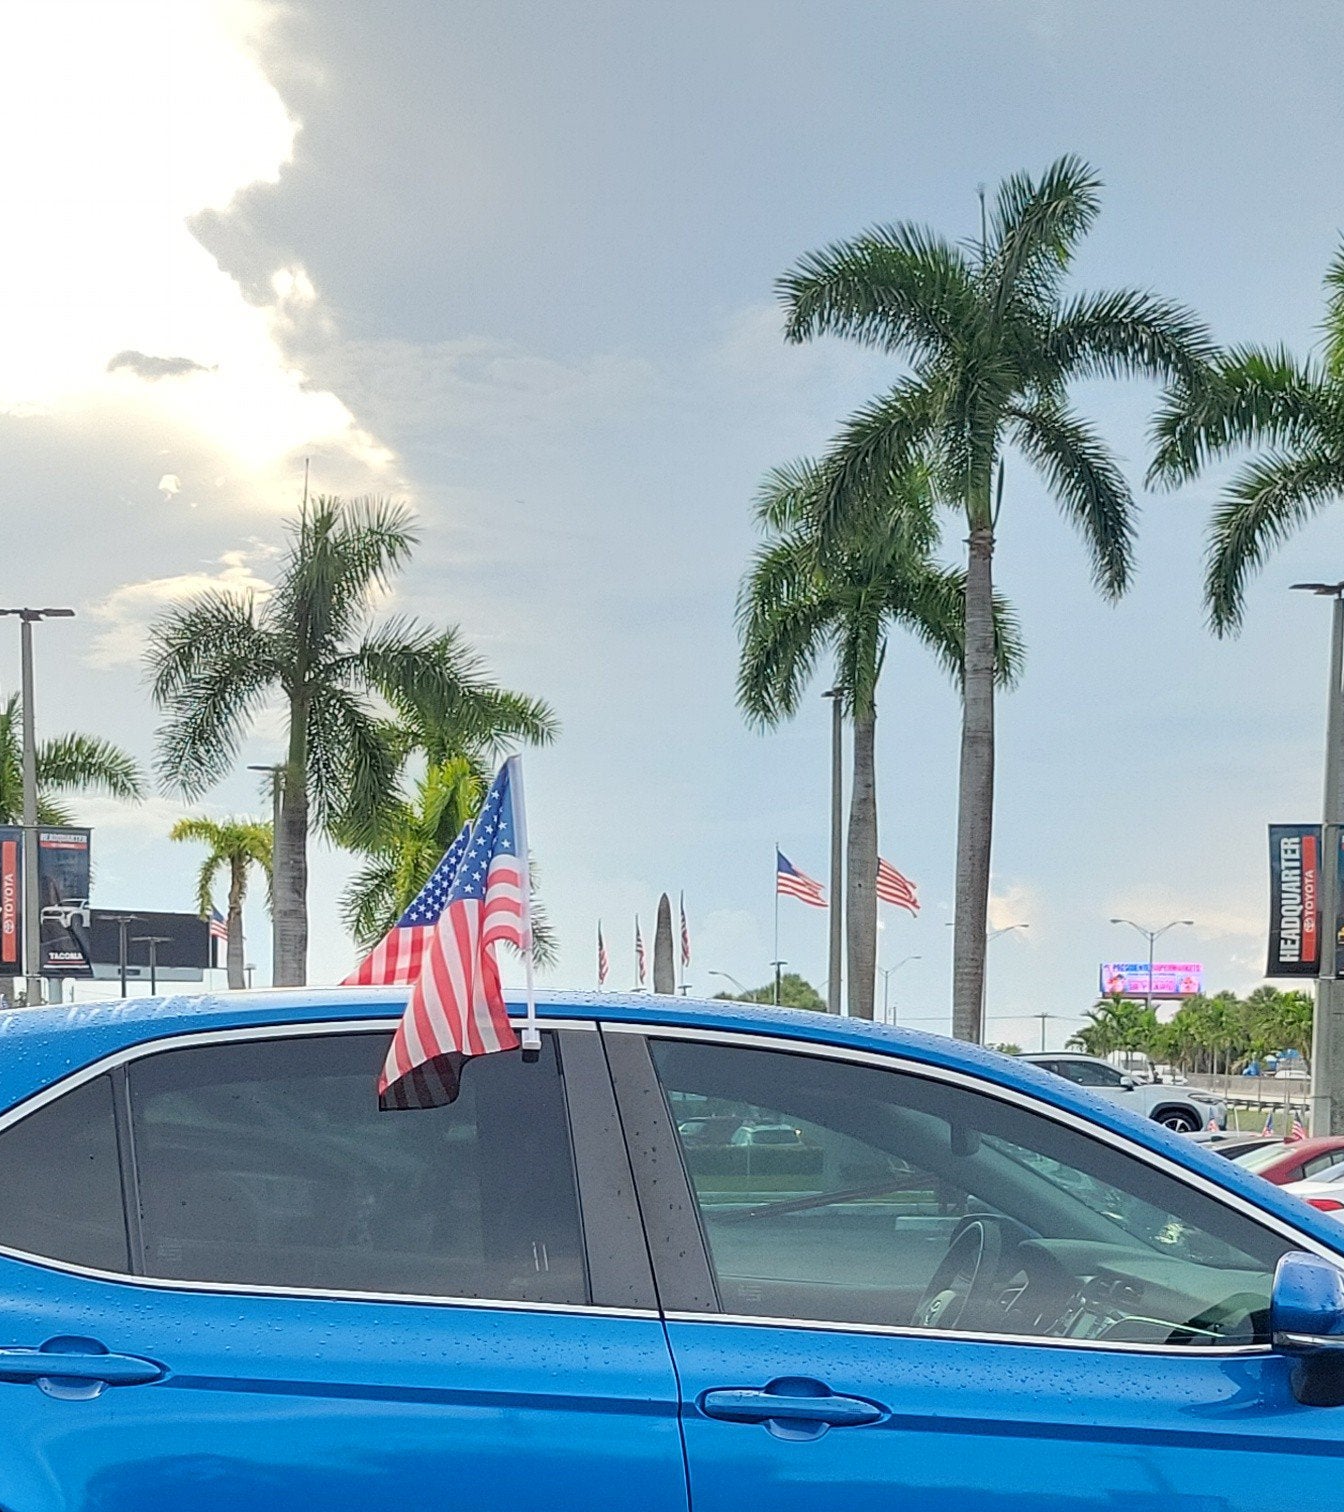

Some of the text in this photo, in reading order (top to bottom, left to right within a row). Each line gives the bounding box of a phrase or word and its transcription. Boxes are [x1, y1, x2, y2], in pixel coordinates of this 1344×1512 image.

[4, 874, 14, 920] TOYOTA
[1279, 836, 1304, 963] HEADQUARTER
[1304, 869, 1315, 921] TOYOTA
[49, 951, 84, 960] TACOMA
